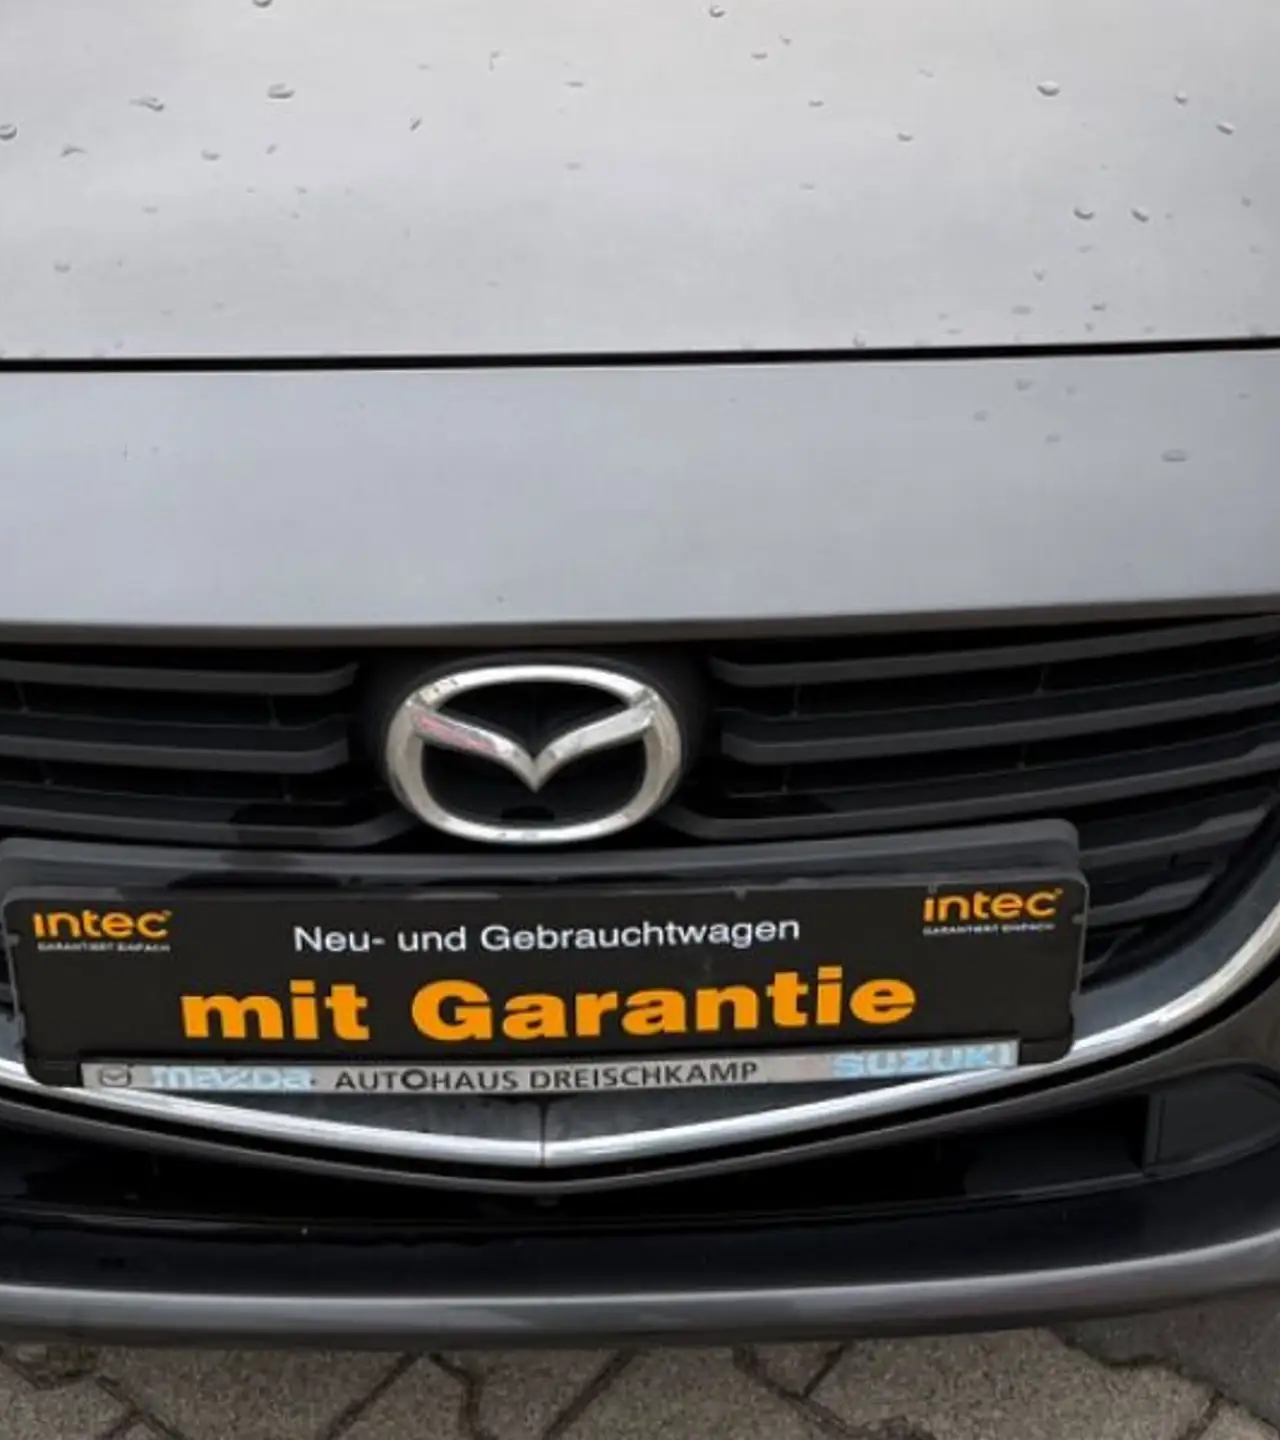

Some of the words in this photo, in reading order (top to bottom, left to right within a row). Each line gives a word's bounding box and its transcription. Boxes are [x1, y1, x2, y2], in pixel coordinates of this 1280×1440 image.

[923, 889, 1060, 922] intec
[33, 910, 170, 939] intec
[293, 925, 386, 952] Neu-
[397, 925, 468, 952] und
[480, 918, 801, 951] Gebrauchtwagen
[181, 980, 371, 1041] mit
[411, 966, 917, 1041] Garantie
[334, 1067, 519, 1092] AUTOHAUS
[529, 1061, 758, 1091] DREISCHKAMP
[833, 1043, 1018, 1078] SUZUKI
